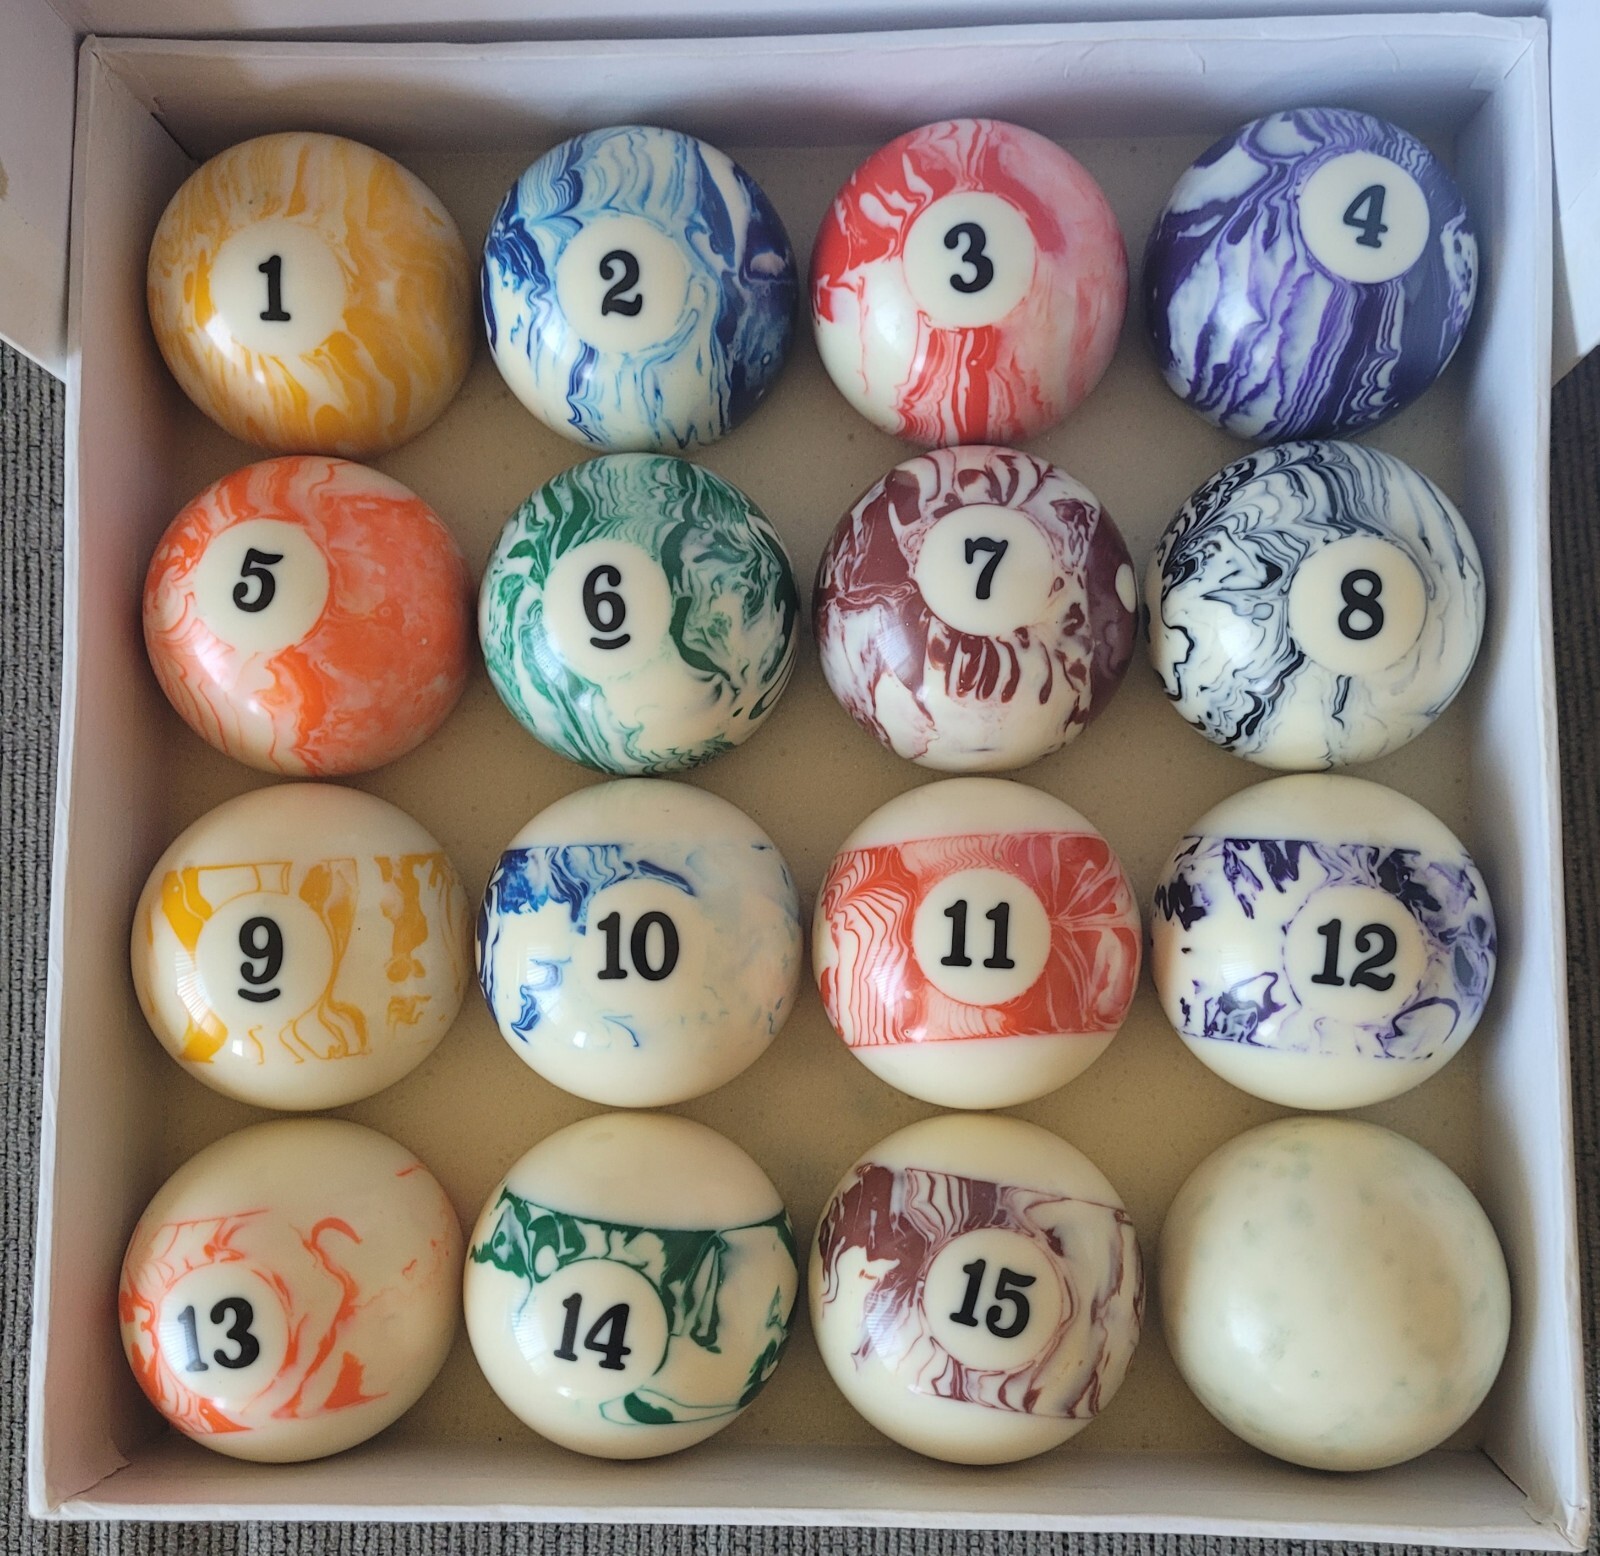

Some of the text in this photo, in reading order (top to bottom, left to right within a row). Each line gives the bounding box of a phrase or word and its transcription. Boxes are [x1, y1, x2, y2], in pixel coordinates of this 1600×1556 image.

[1342, 184, 1389, 249] 4
[257, 254, 292, 322] 1
[598, 249, 644, 317] 2
[943, 221, 995, 294] 3
[232, 547, 285, 613] 5
[964, 536, 1009, 601] 7
[1337, 568, 1385, 641] 8
[582, 564, 631, 650] 6
[237, 915, 285, 1004] 9
[596, 910, 680, 982] 10
[940, 899, 1016, 970] 11
[1310, 918, 1398, 992] 12
[177, 1296, 261, 1372] 13
[553, 1292, 632, 1371] 14
[949, 1258, 1038, 1339] 15
